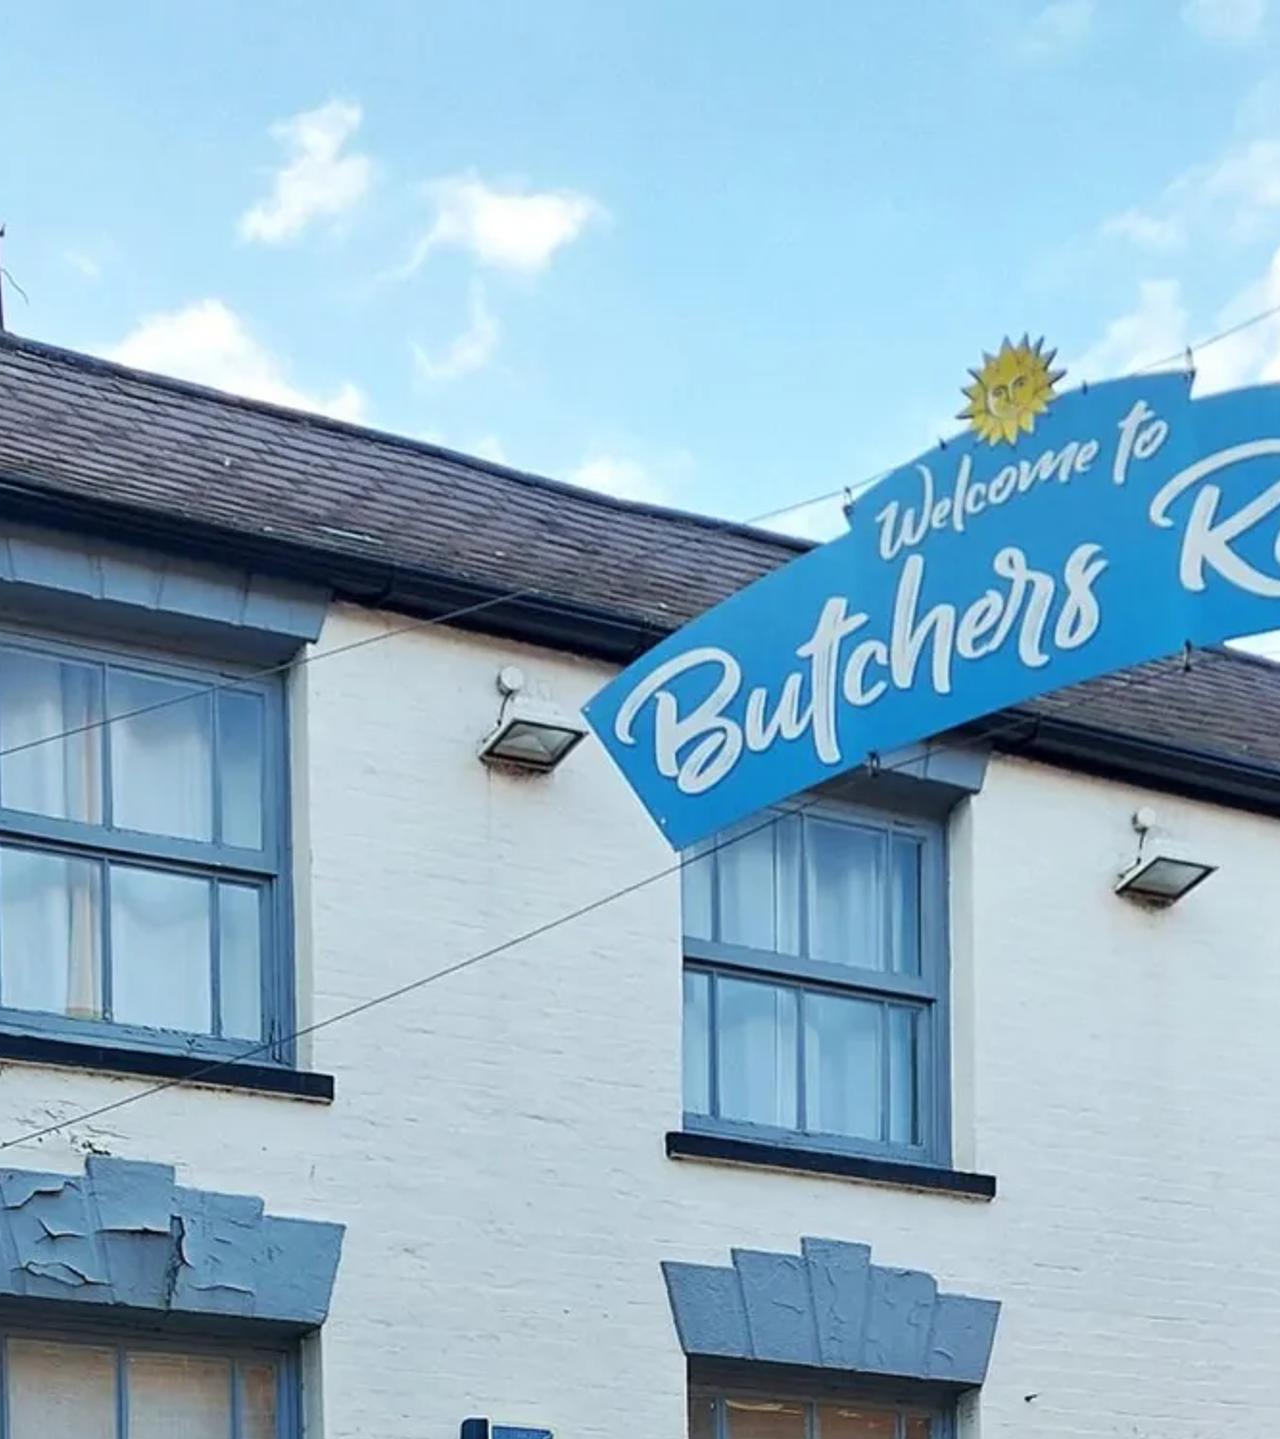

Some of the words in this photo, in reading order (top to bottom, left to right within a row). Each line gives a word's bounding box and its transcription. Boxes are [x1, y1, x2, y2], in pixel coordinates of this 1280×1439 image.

[878, 438, 1100, 563] Welcome
[1111, 400, 1169, 485] to
[613, 540, 1111, 796] Butchers
